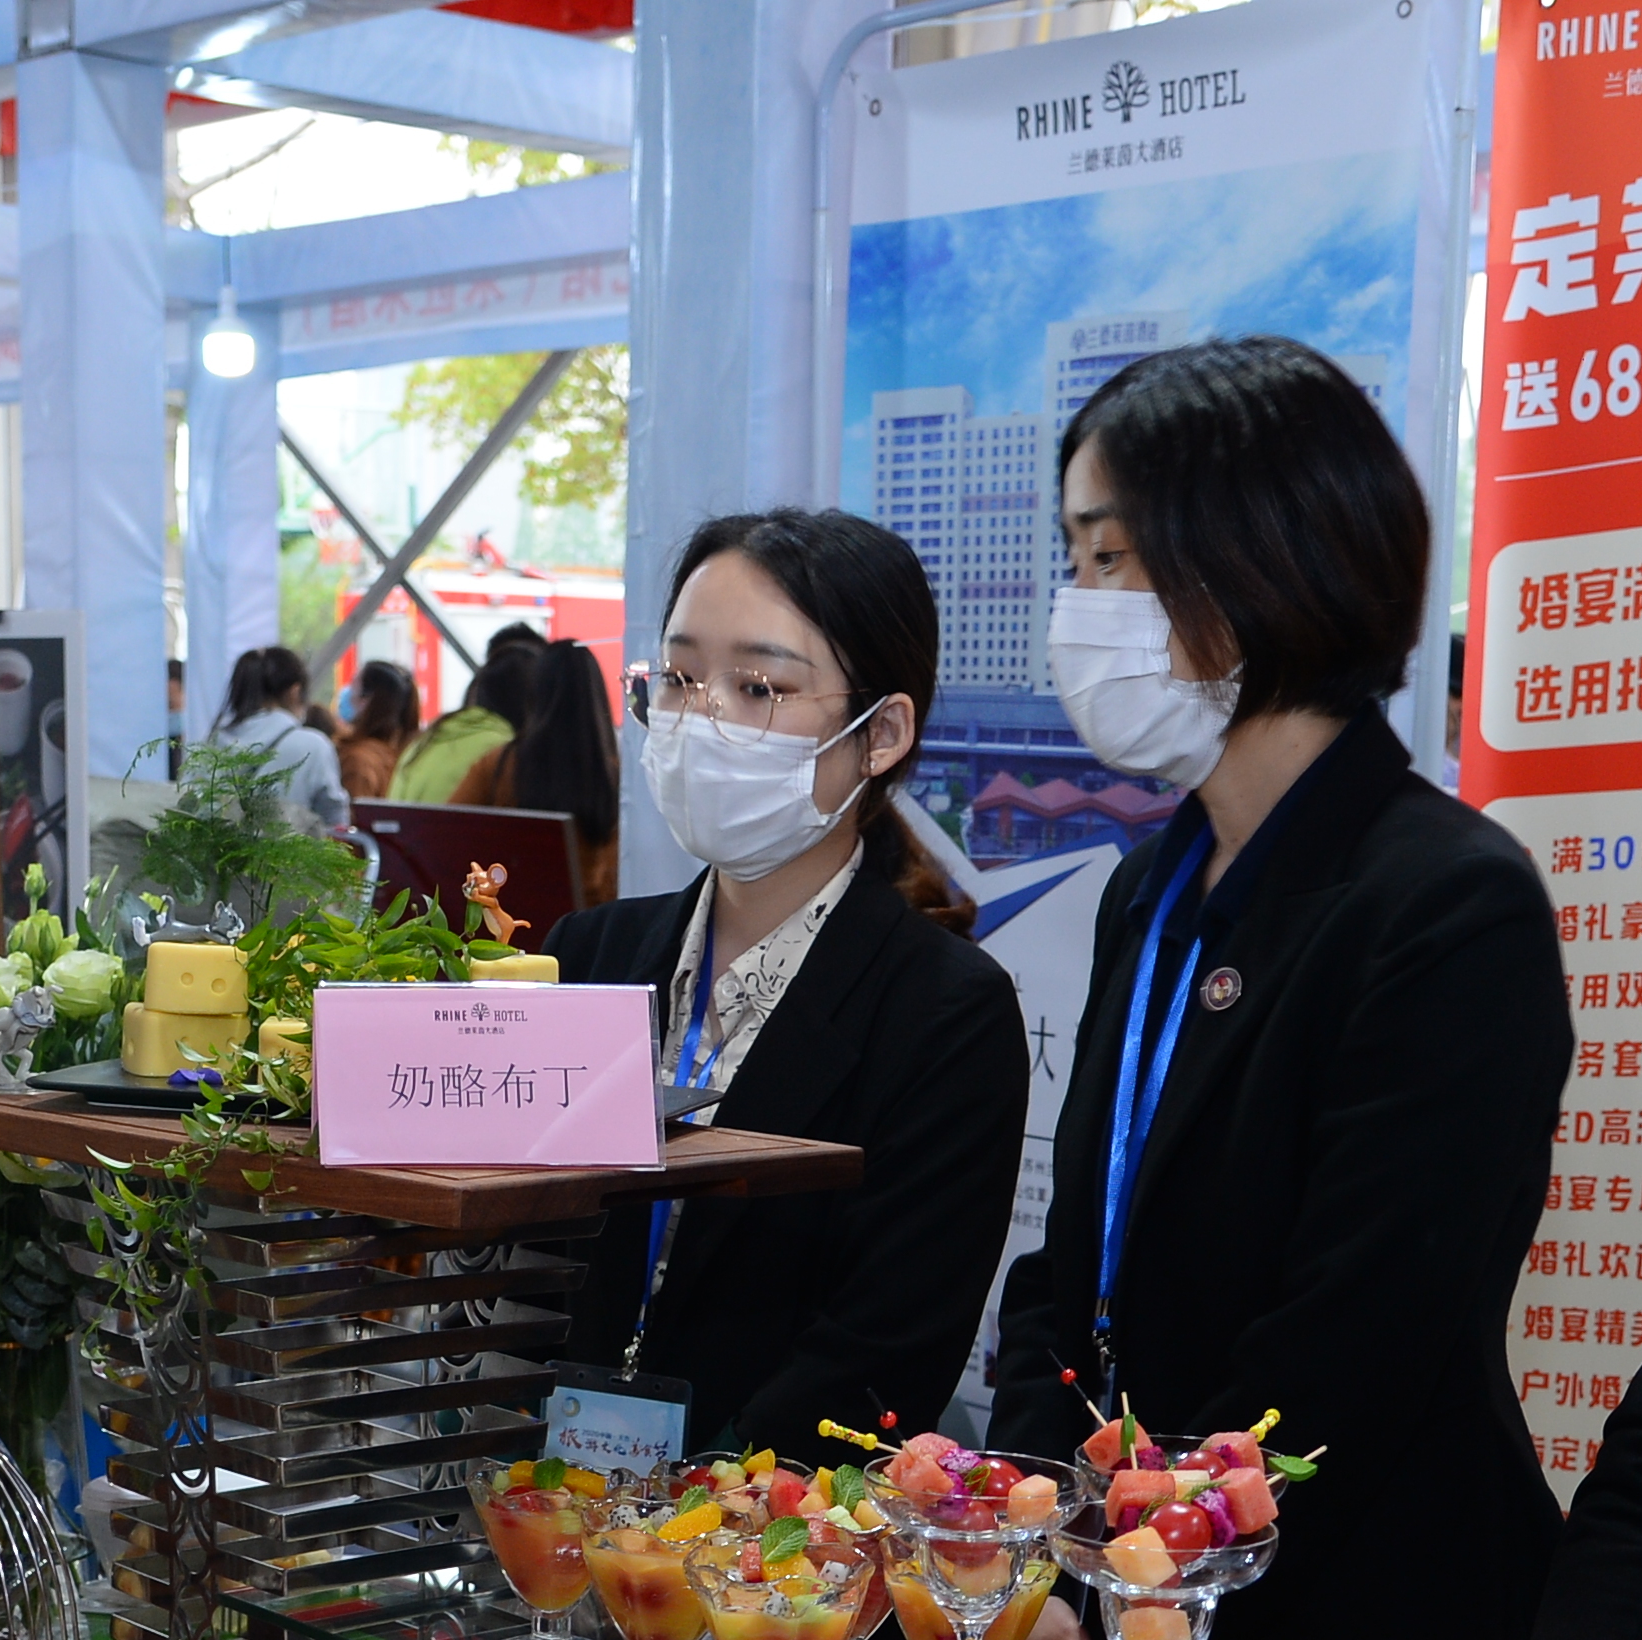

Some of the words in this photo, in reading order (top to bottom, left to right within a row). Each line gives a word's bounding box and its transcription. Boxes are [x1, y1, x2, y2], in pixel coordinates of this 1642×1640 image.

[1537, 10, 1640, 61] RHINE
[1017, 94, 1092, 141] RHINE
[1160, 69, 1246, 117] HOTEL
[434, 1009, 468, 1022] RHINE
[494, 1010, 528, 1022] HOTEL
[1029, 1016, 1056, 1082] 大
[387, 1062, 588, 1109] 奶酪布丁
